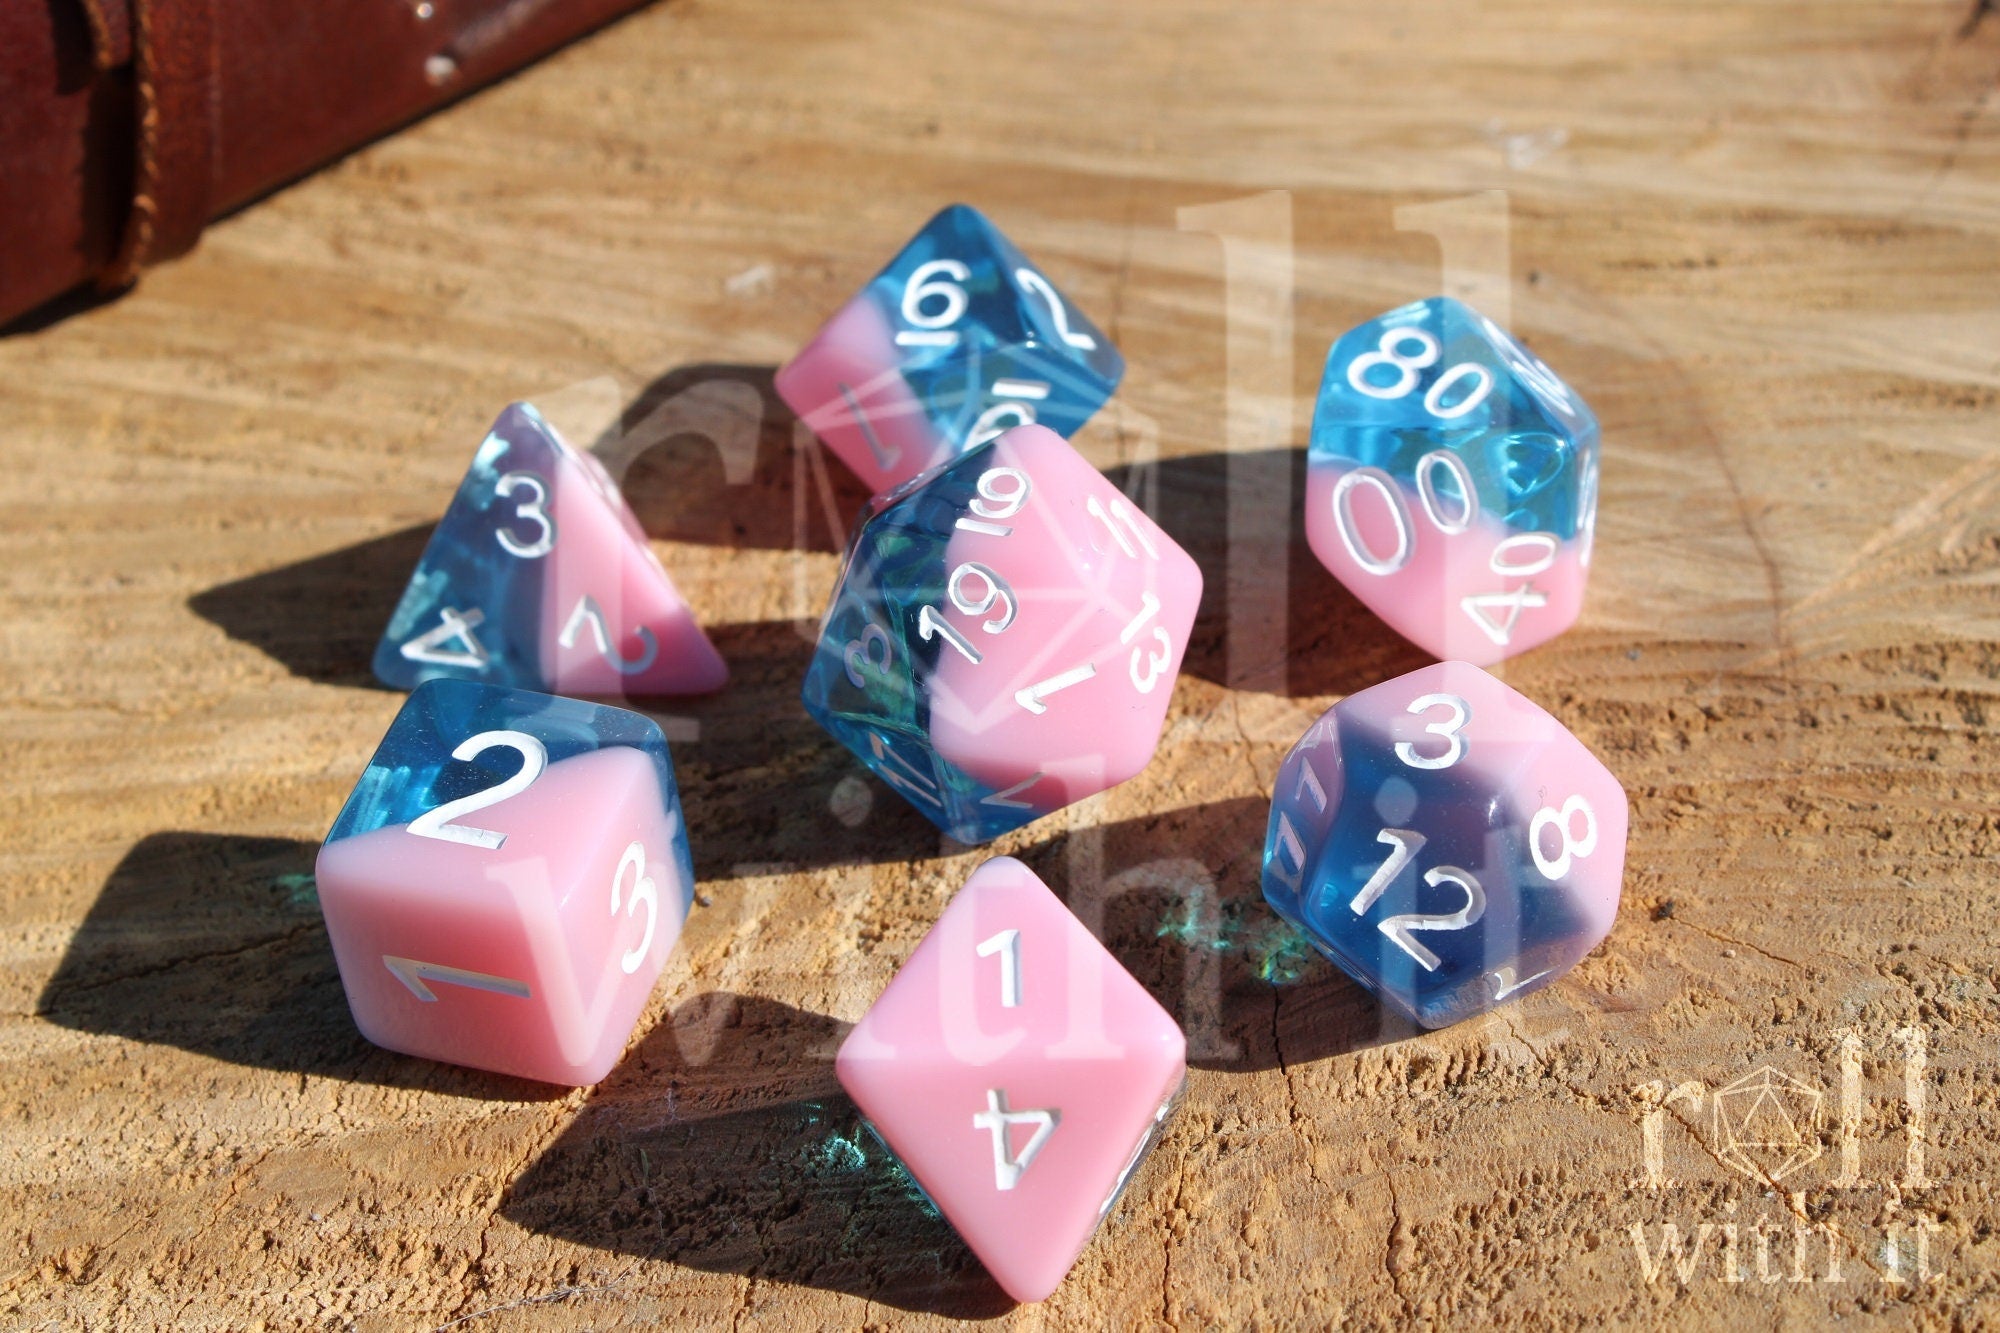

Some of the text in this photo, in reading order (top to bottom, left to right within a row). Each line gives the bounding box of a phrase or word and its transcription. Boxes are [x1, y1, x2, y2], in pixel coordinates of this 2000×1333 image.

[895, 259, 971, 346] 6
[1347, 327, 1495, 418] 80
[494, 470, 558, 559] 3
[1087, 494, 1160, 560] 11
[1332, 450, 1479, 575] 00
[919, 561, 1018, 664] 19
[1460, 531, 1562, 645] 40
[400, 606, 488, 668] 4
[558, 594, 659, 675] 2
[844, 623, 892, 688] 3
[1120, 590, 1171, 693] 13
[1014, 662, 1096, 714] 1
[1394, 693, 1474, 770] 3
[406, 730, 548, 850] 2
[1529, 795, 1598, 880] 8
[610, 840, 658, 975] 3
[1349, 828, 1487, 972] 12
[382, 955, 533, 1002] 1
[976, 929, 1023, 1008] 1
[973, 1089, 1062, 1191] 4
